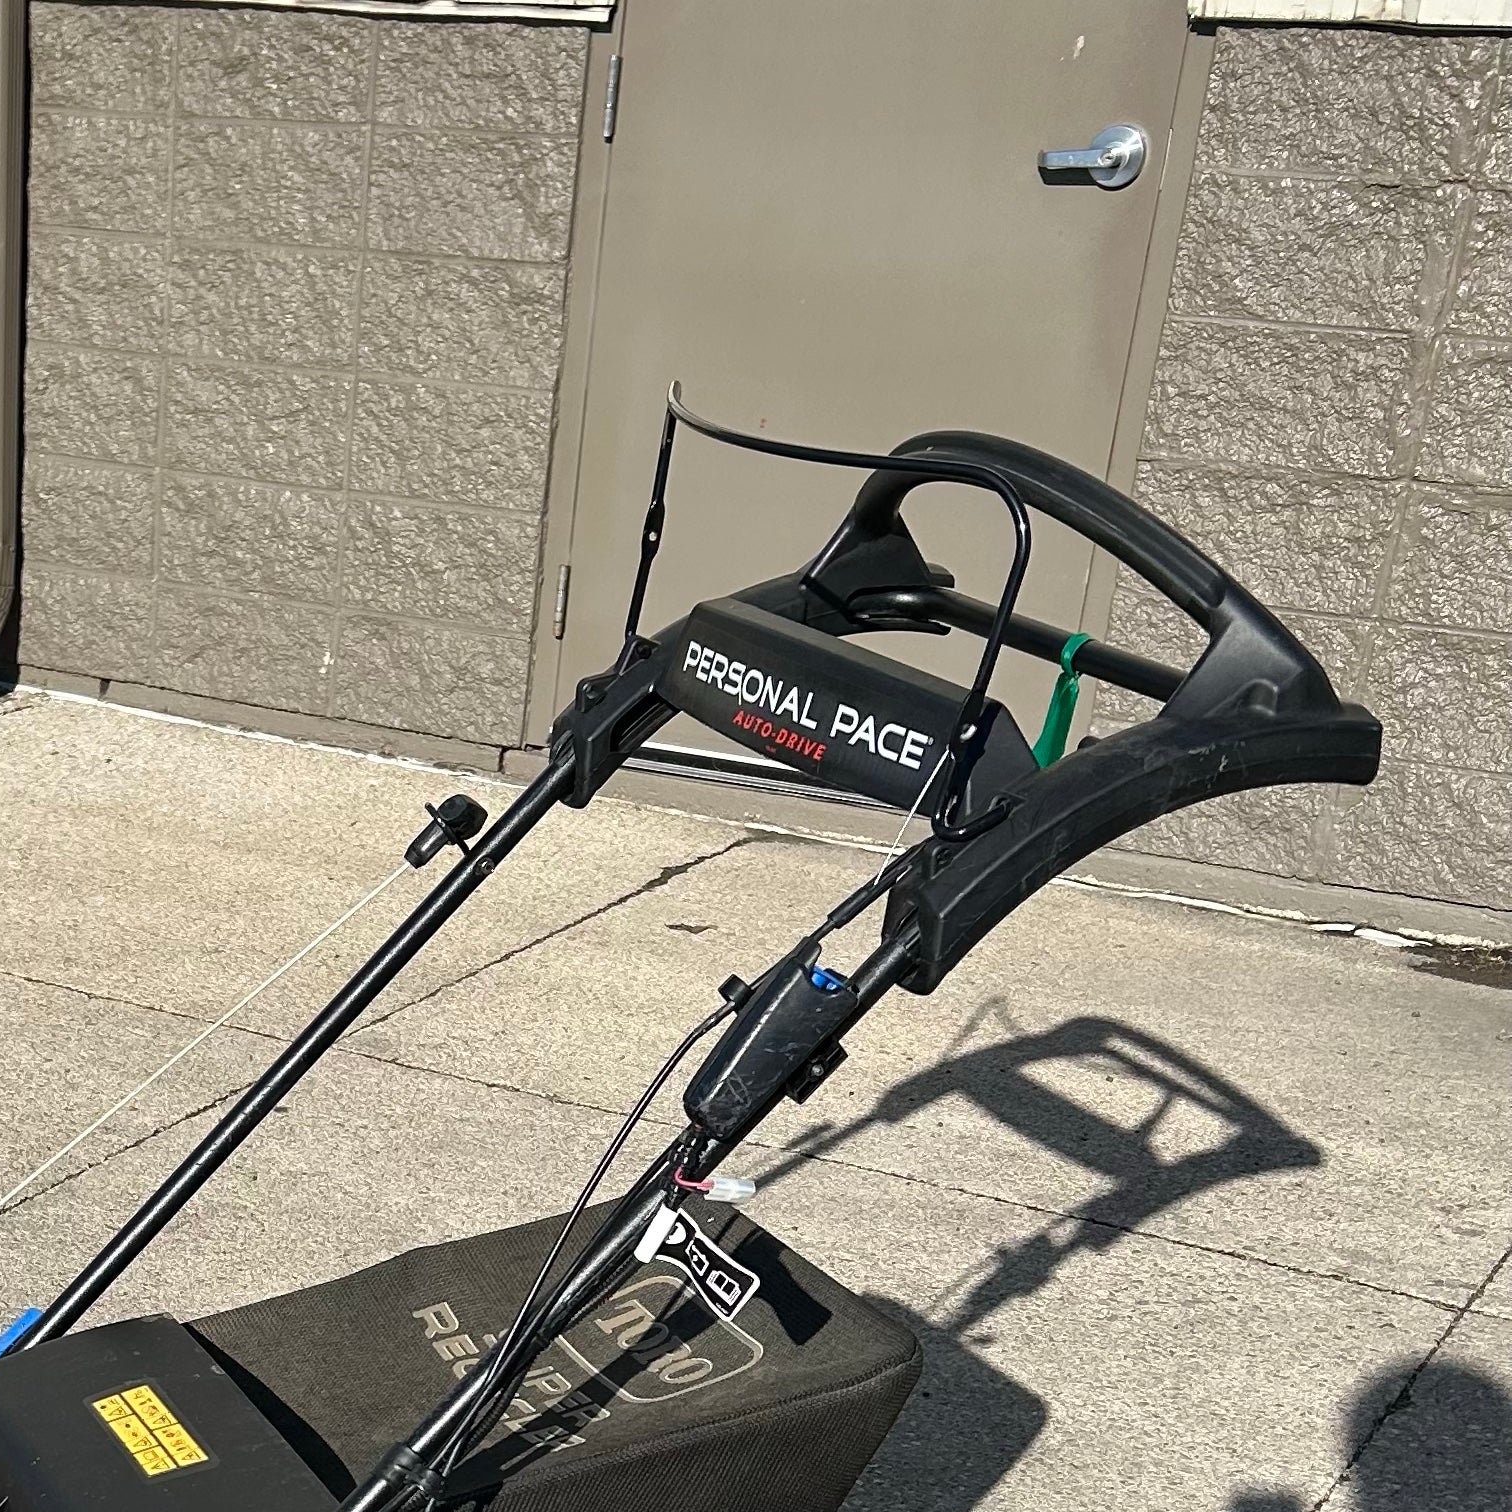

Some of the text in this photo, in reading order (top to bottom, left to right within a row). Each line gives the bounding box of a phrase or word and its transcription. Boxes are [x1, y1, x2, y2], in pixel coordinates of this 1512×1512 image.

[683, 640, 818, 730] PERSONAL
[732, 710, 827, 761] AUTO-DRIVE
[594, 1299, 714, 1384] TORO
